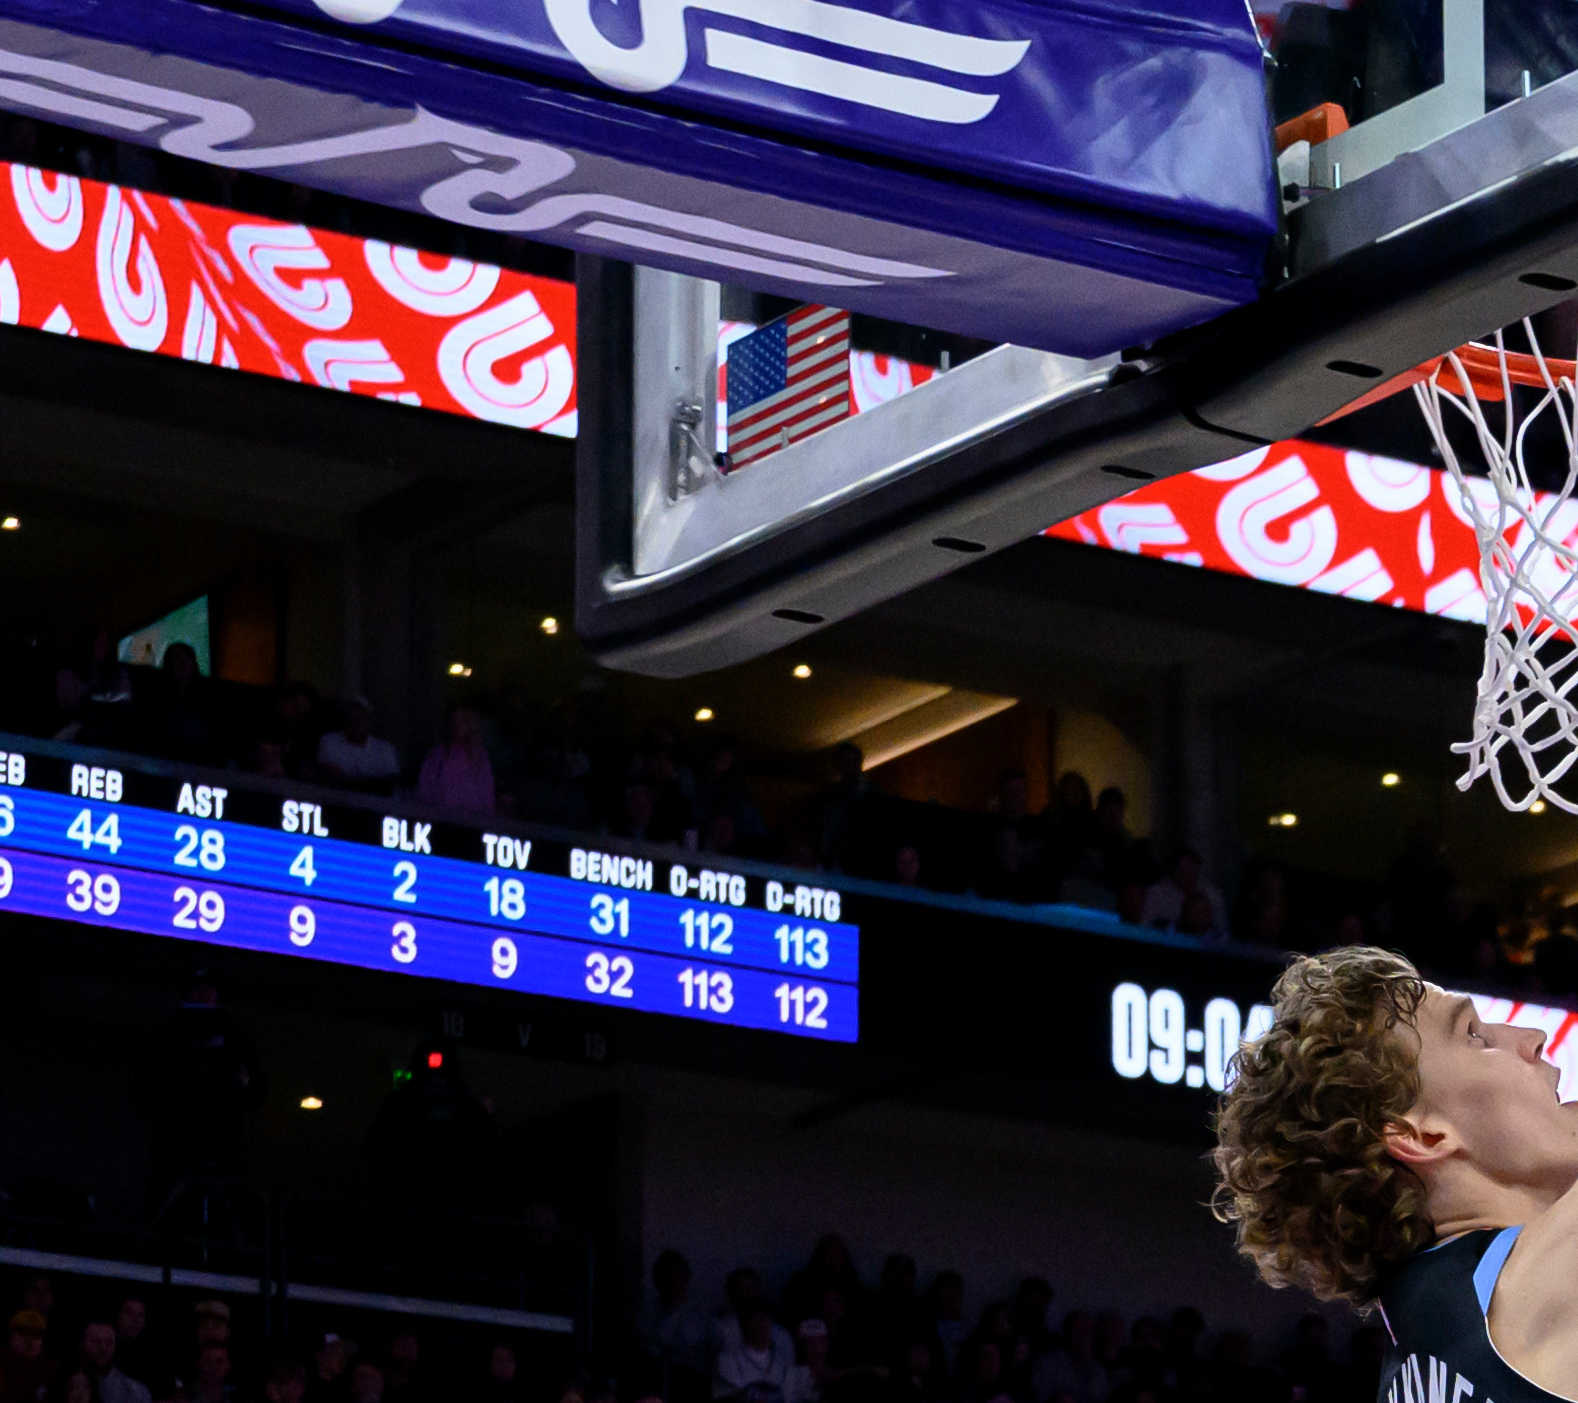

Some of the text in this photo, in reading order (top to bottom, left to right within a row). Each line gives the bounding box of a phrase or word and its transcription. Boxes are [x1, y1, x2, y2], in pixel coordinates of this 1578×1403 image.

[67, 808, 122, 854] 44
[174, 824, 226, 871] 28
[289, 845, 317, 886] 4
[393, 860, 417, 903] 2
[484, 876, 526, 920] 18
[589, 893, 629, 937] 31
[679, 908, 734, 954] 112
[774, 924, 829, 969] 113
[71, 763, 123, 802] REB
[176, 782, 228, 820] AST
[281, 800, 329, 837] STL
[382, 816, 432, 855] BLK
[482, 833, 532, 870] TOV
[569, 848, 653, 891] BENCH
[669, 864, 746, 906] O-RTG
[765, 880, 841, 922] D-RTG
[66, 869, 121, 916] 39
[172, 886, 226, 933] 29
[288, 904, 316, 947] 9
[391, 921, 418, 964] 3
[491, 936, 518, 979] 9
[585, 951, 634, 999] 32
[677, 967, 734, 1014] 113
[774, 982, 829, 1029] 112
